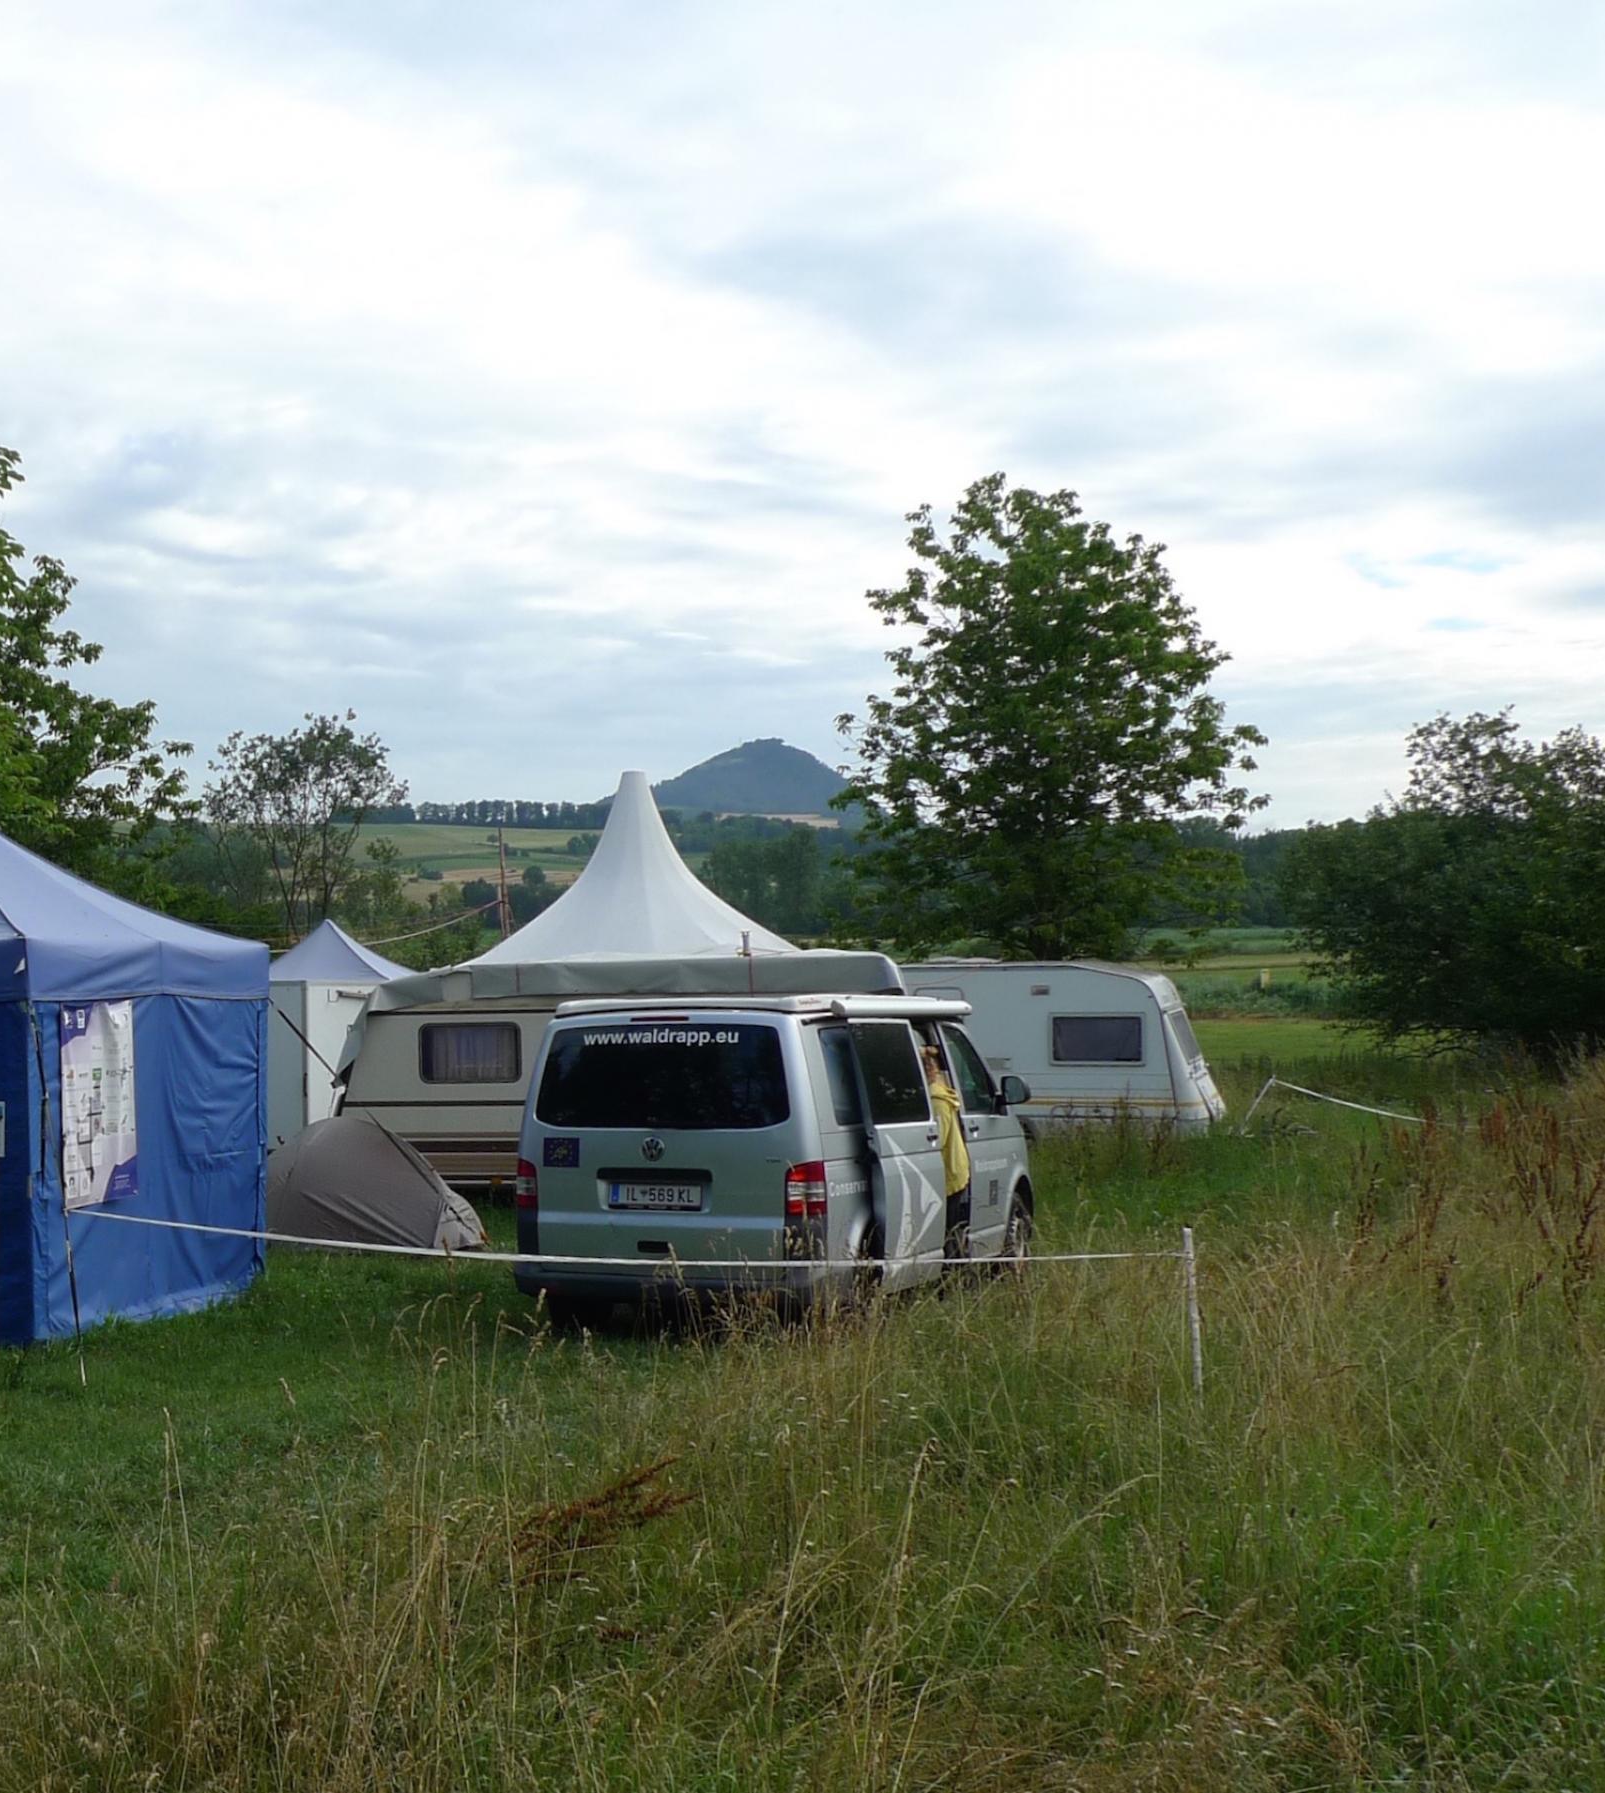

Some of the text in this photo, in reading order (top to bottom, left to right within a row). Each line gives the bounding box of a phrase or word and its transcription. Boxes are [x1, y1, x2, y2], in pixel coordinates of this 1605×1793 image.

[583, 1028, 740, 1047] www.waldrapp.eu
[626, 1186, 694, 1204] IL 569 KL
